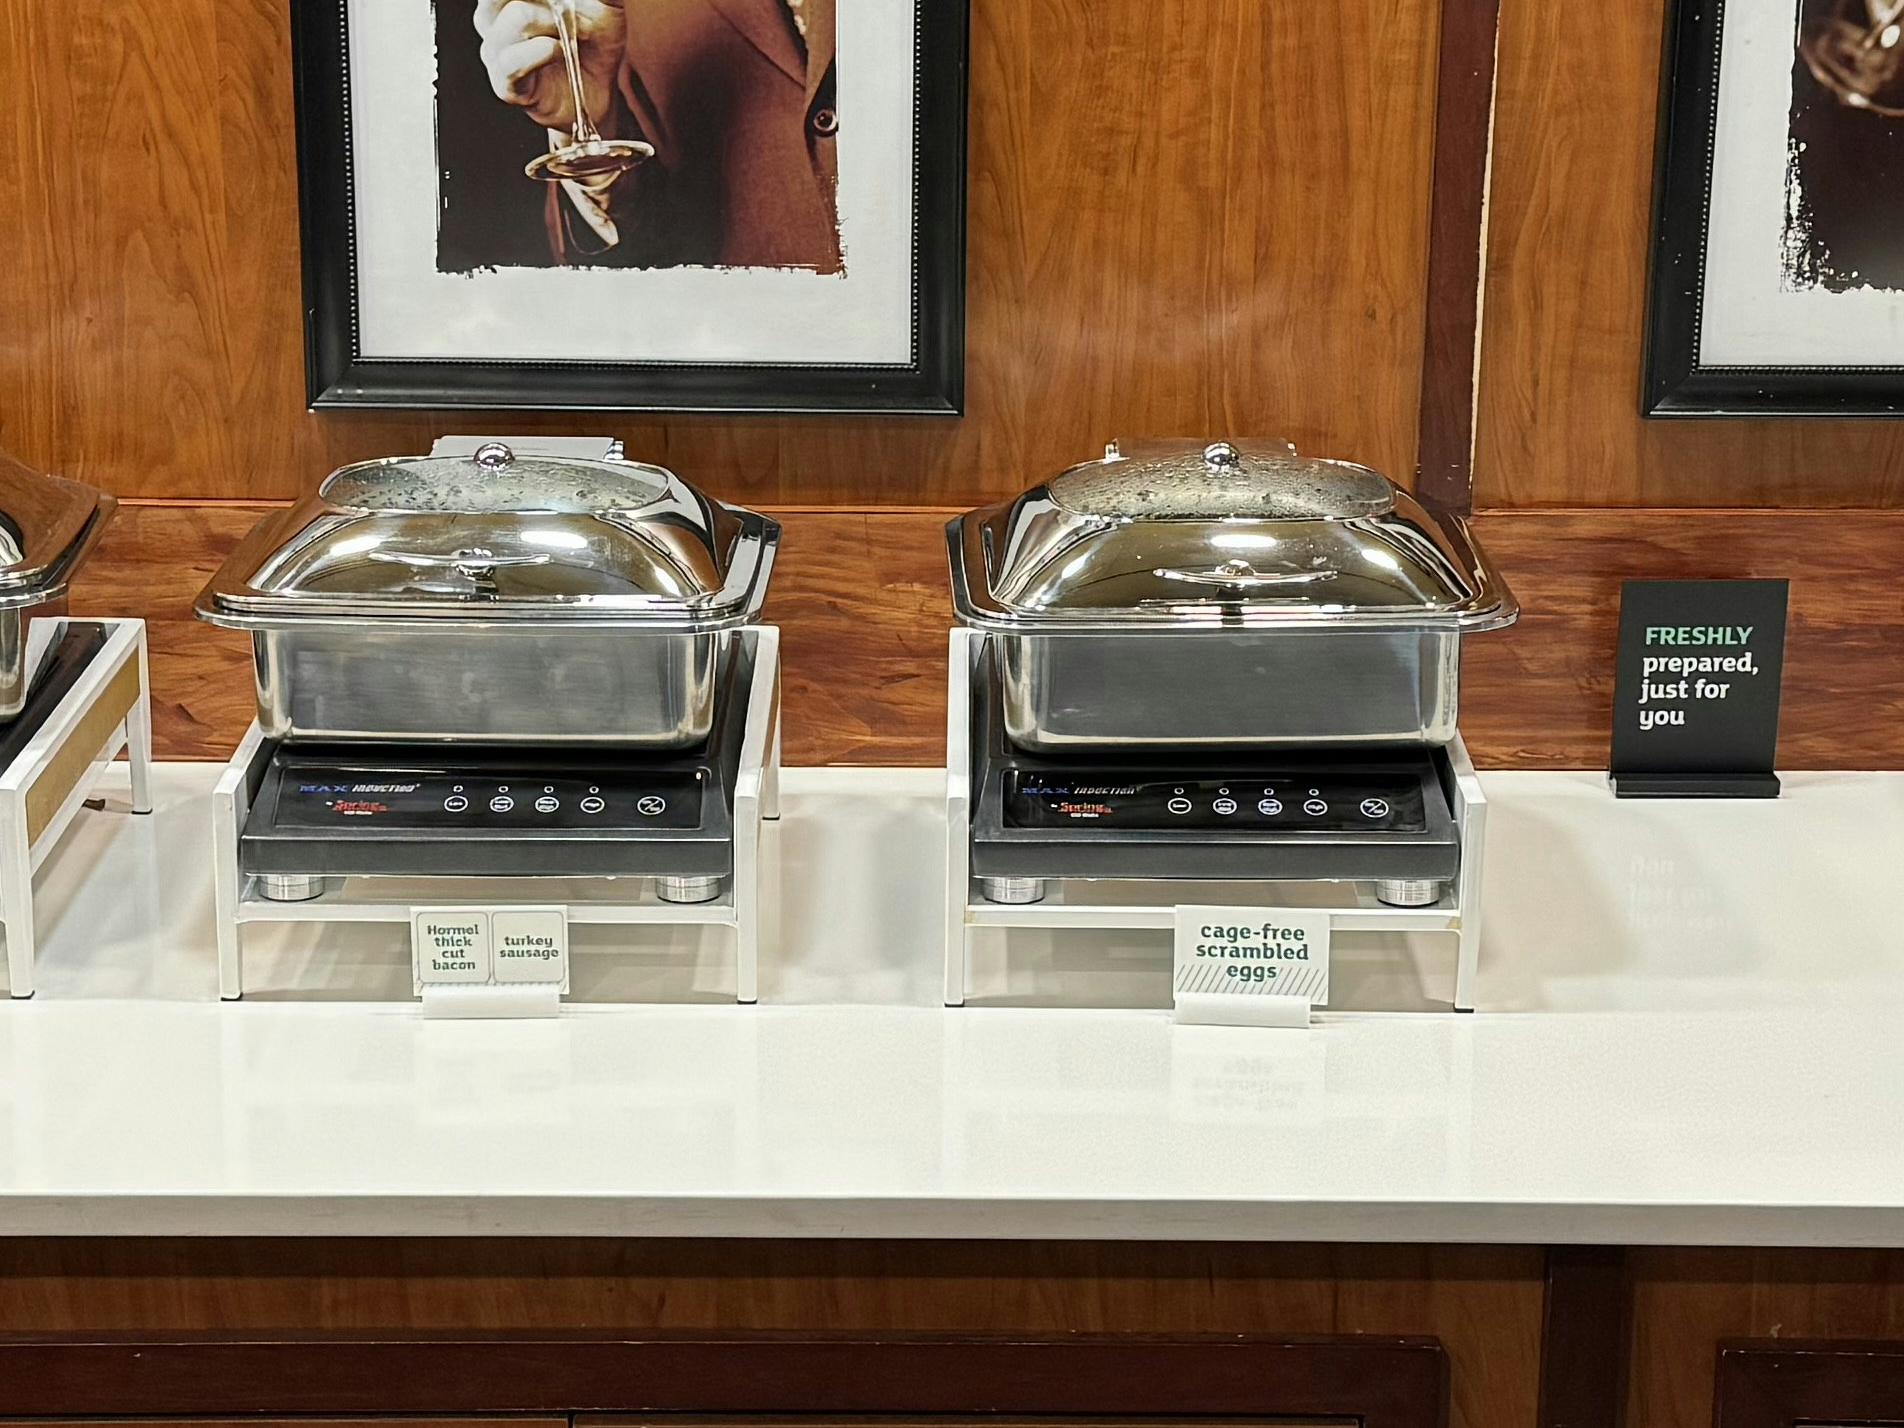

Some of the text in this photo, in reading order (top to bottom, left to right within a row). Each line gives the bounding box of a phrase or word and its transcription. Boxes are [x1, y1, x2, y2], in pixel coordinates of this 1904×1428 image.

[1645, 626, 1754, 645] FRESHLY
[1642, 651, 1759, 677] prepared,
[1638, 678, 1730, 704] just for
[1639, 710, 1685, 731] you
[299, 784, 349, 793] MAX
[434, 936, 473, 947] thick
[504, 935, 554, 948] turkey
[1200, 923, 1306, 943] cage-free
[441, 948, 466, 959] cut
[499, 948, 560, 961] sausage
[1196, 943, 1310, 961] scrambled
[431, 959, 477, 971] bacon
[1226, 965, 1278, 983] eggs
